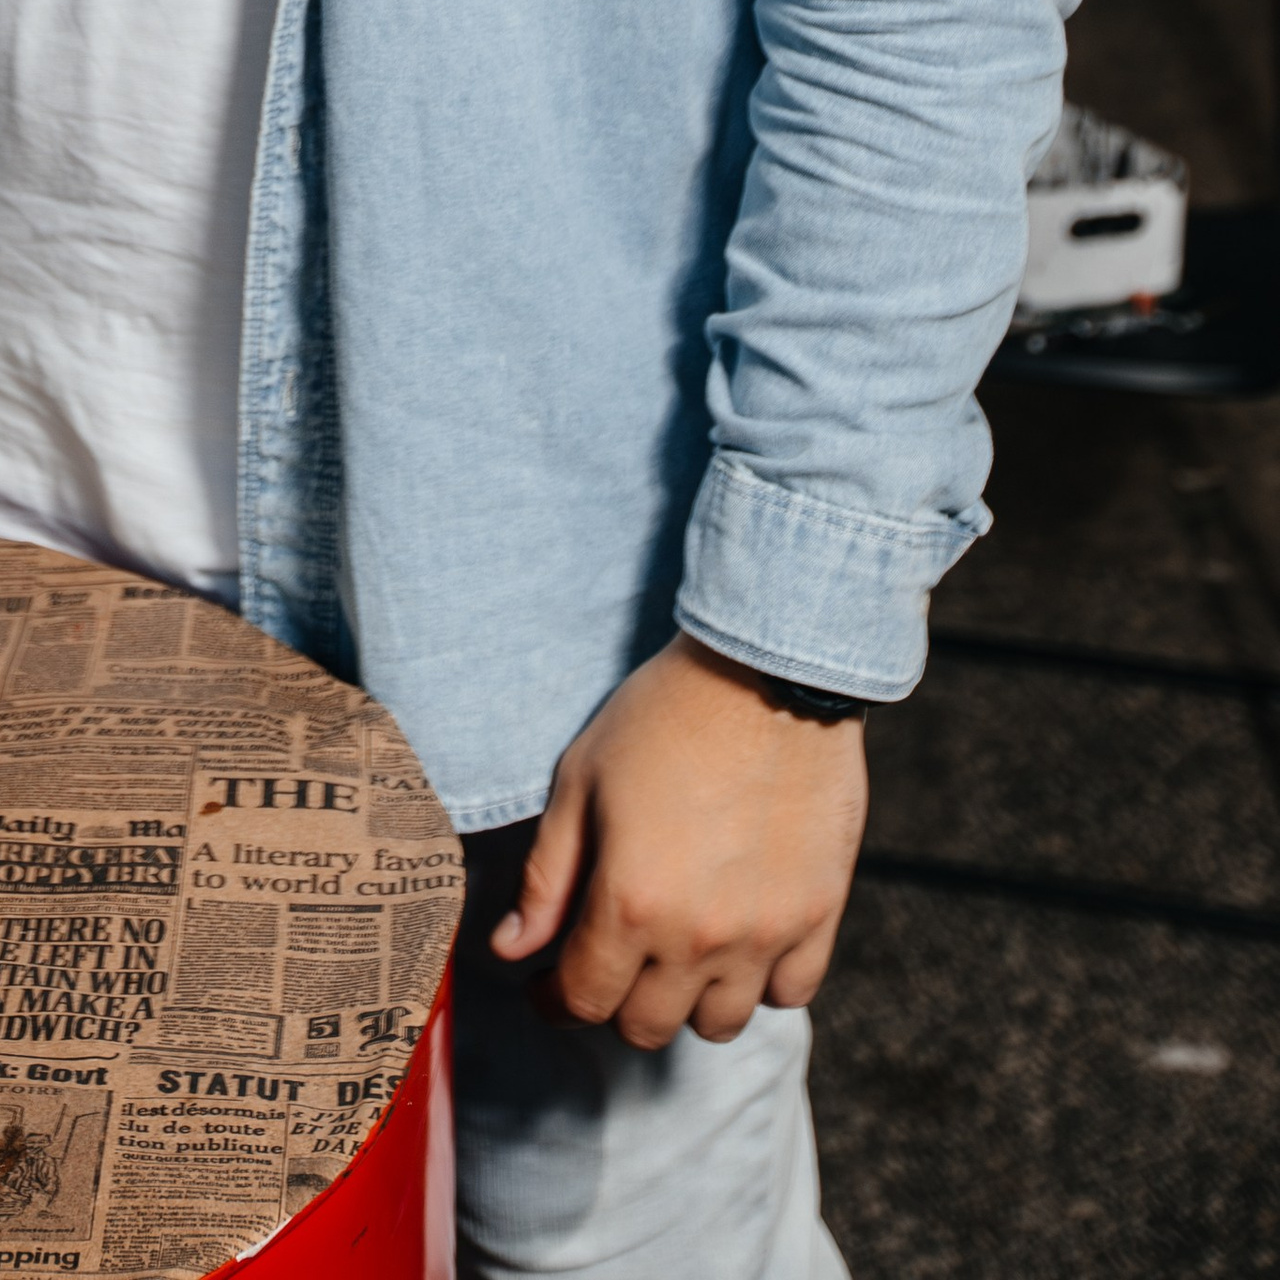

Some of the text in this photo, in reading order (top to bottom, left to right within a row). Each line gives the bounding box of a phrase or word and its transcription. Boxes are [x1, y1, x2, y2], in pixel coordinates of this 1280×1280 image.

[209, 777, 361, 814] THE
[191, 842, 219, 862] A
[232, 842, 360, 874] literary
[191, 869, 227, 889] to
[242, 874, 343, 895] world
[0, 916, 112, 943] THERE
[120, 918, 166, 945] NO
[27, 943, 114, 969] LEFT
[121, 945, 159, 970] IN
[89, 971, 168, 995] WHO
[17, 988, 128, 1019] MAKE
[129, 996, 155, 1020] A
[26, 1062, 109, 1086] Govt
[156, 1069, 306, 1102] STATUT
[171, 1102, 287, 1120] désormais
[163, 1121, 192, 1134] de
[203, 1122, 266, 1136] toute
[290, 1121, 362, 1136] ET DE
[176, 1138, 284, 1155] publique
